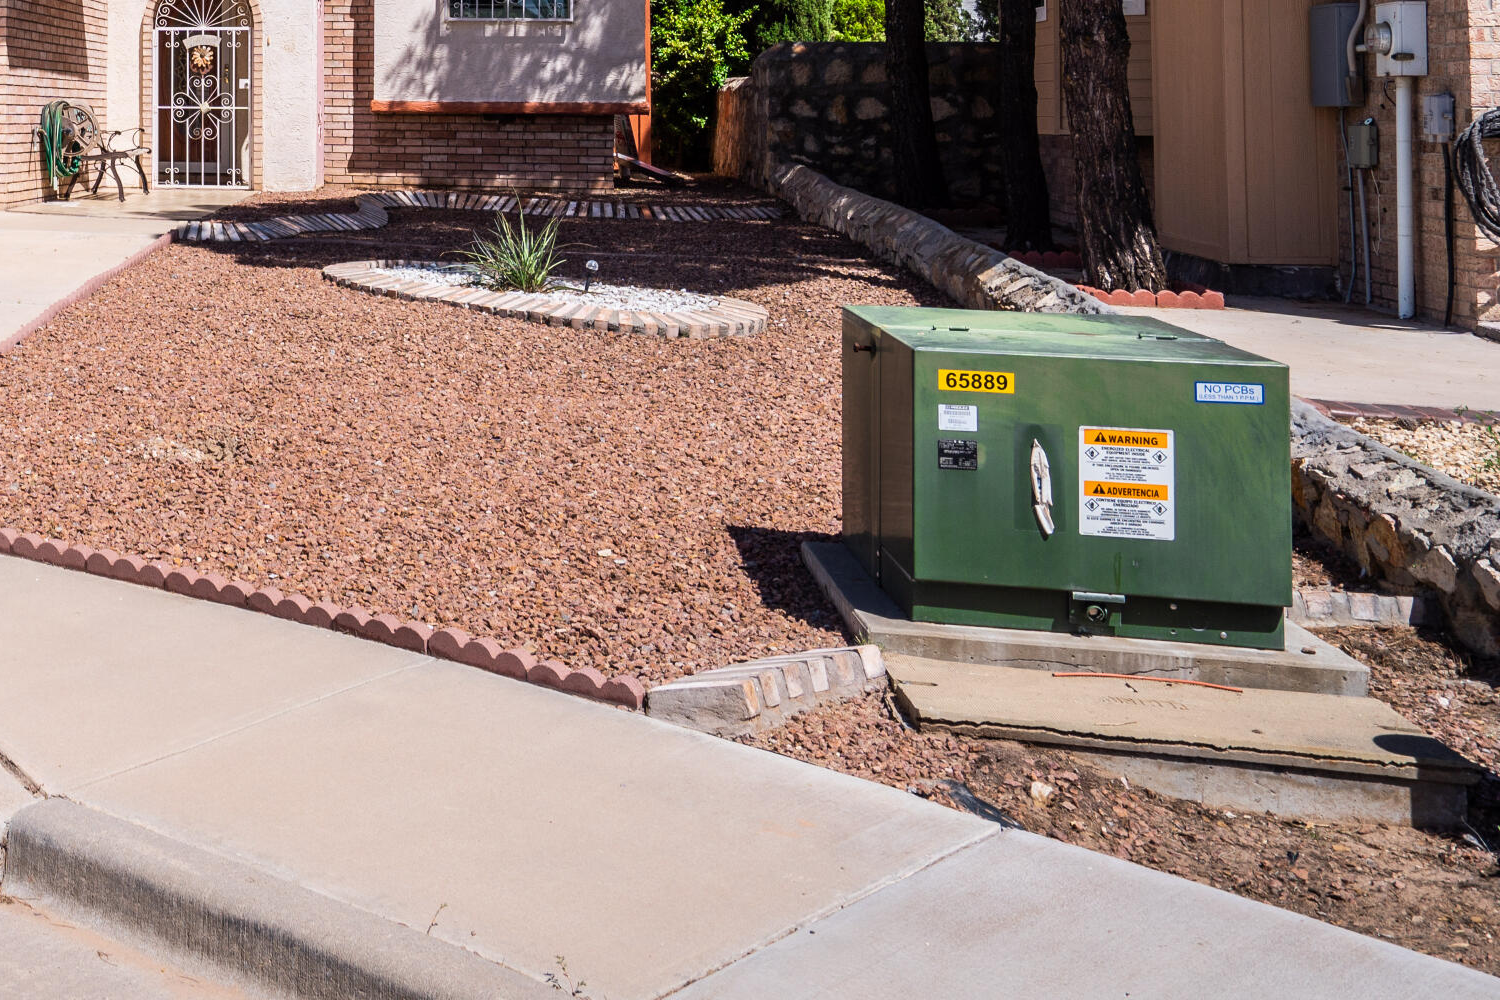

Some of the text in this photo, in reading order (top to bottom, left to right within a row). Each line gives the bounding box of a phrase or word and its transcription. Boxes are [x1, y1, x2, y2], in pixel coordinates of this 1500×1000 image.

[946, 372, 1008, 390] 65889
[1204, 384, 1255, 395] NO PCBs
[1108, 435, 1158, 446] WARNING
[1107, 487, 1160, 498] ADVERTENCIA
